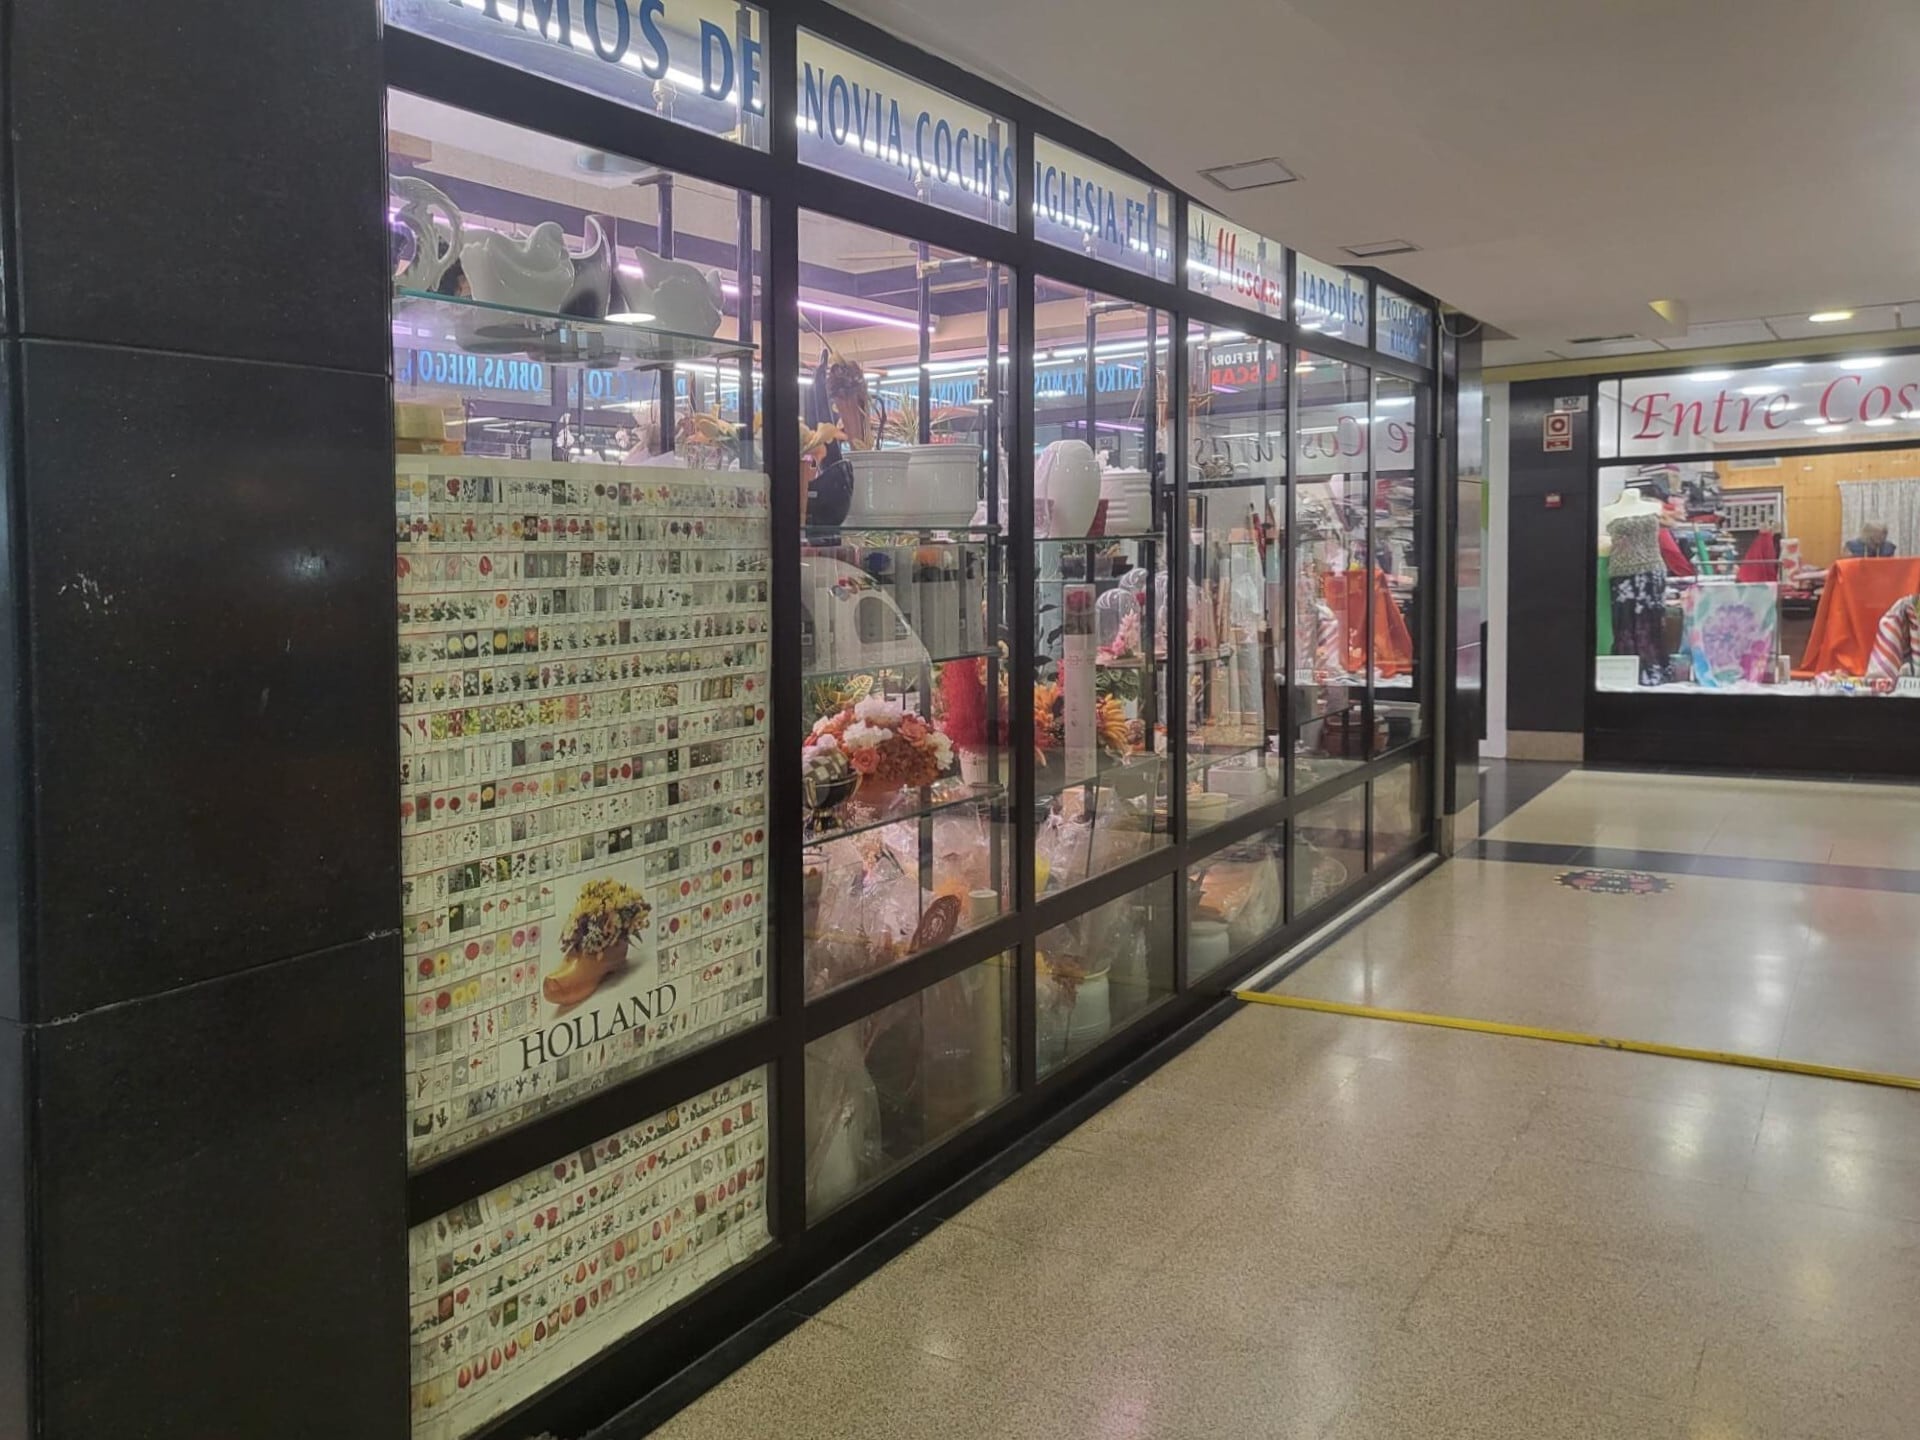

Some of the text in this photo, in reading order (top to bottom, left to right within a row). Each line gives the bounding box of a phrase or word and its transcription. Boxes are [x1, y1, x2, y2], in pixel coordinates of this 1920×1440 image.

[699, 18, 765, 118] DE
[1301, 270, 1365, 328] JARDINES
[1630, 389, 1792, 440] Entre
[519, 984, 677, 1072] HOLLAND
